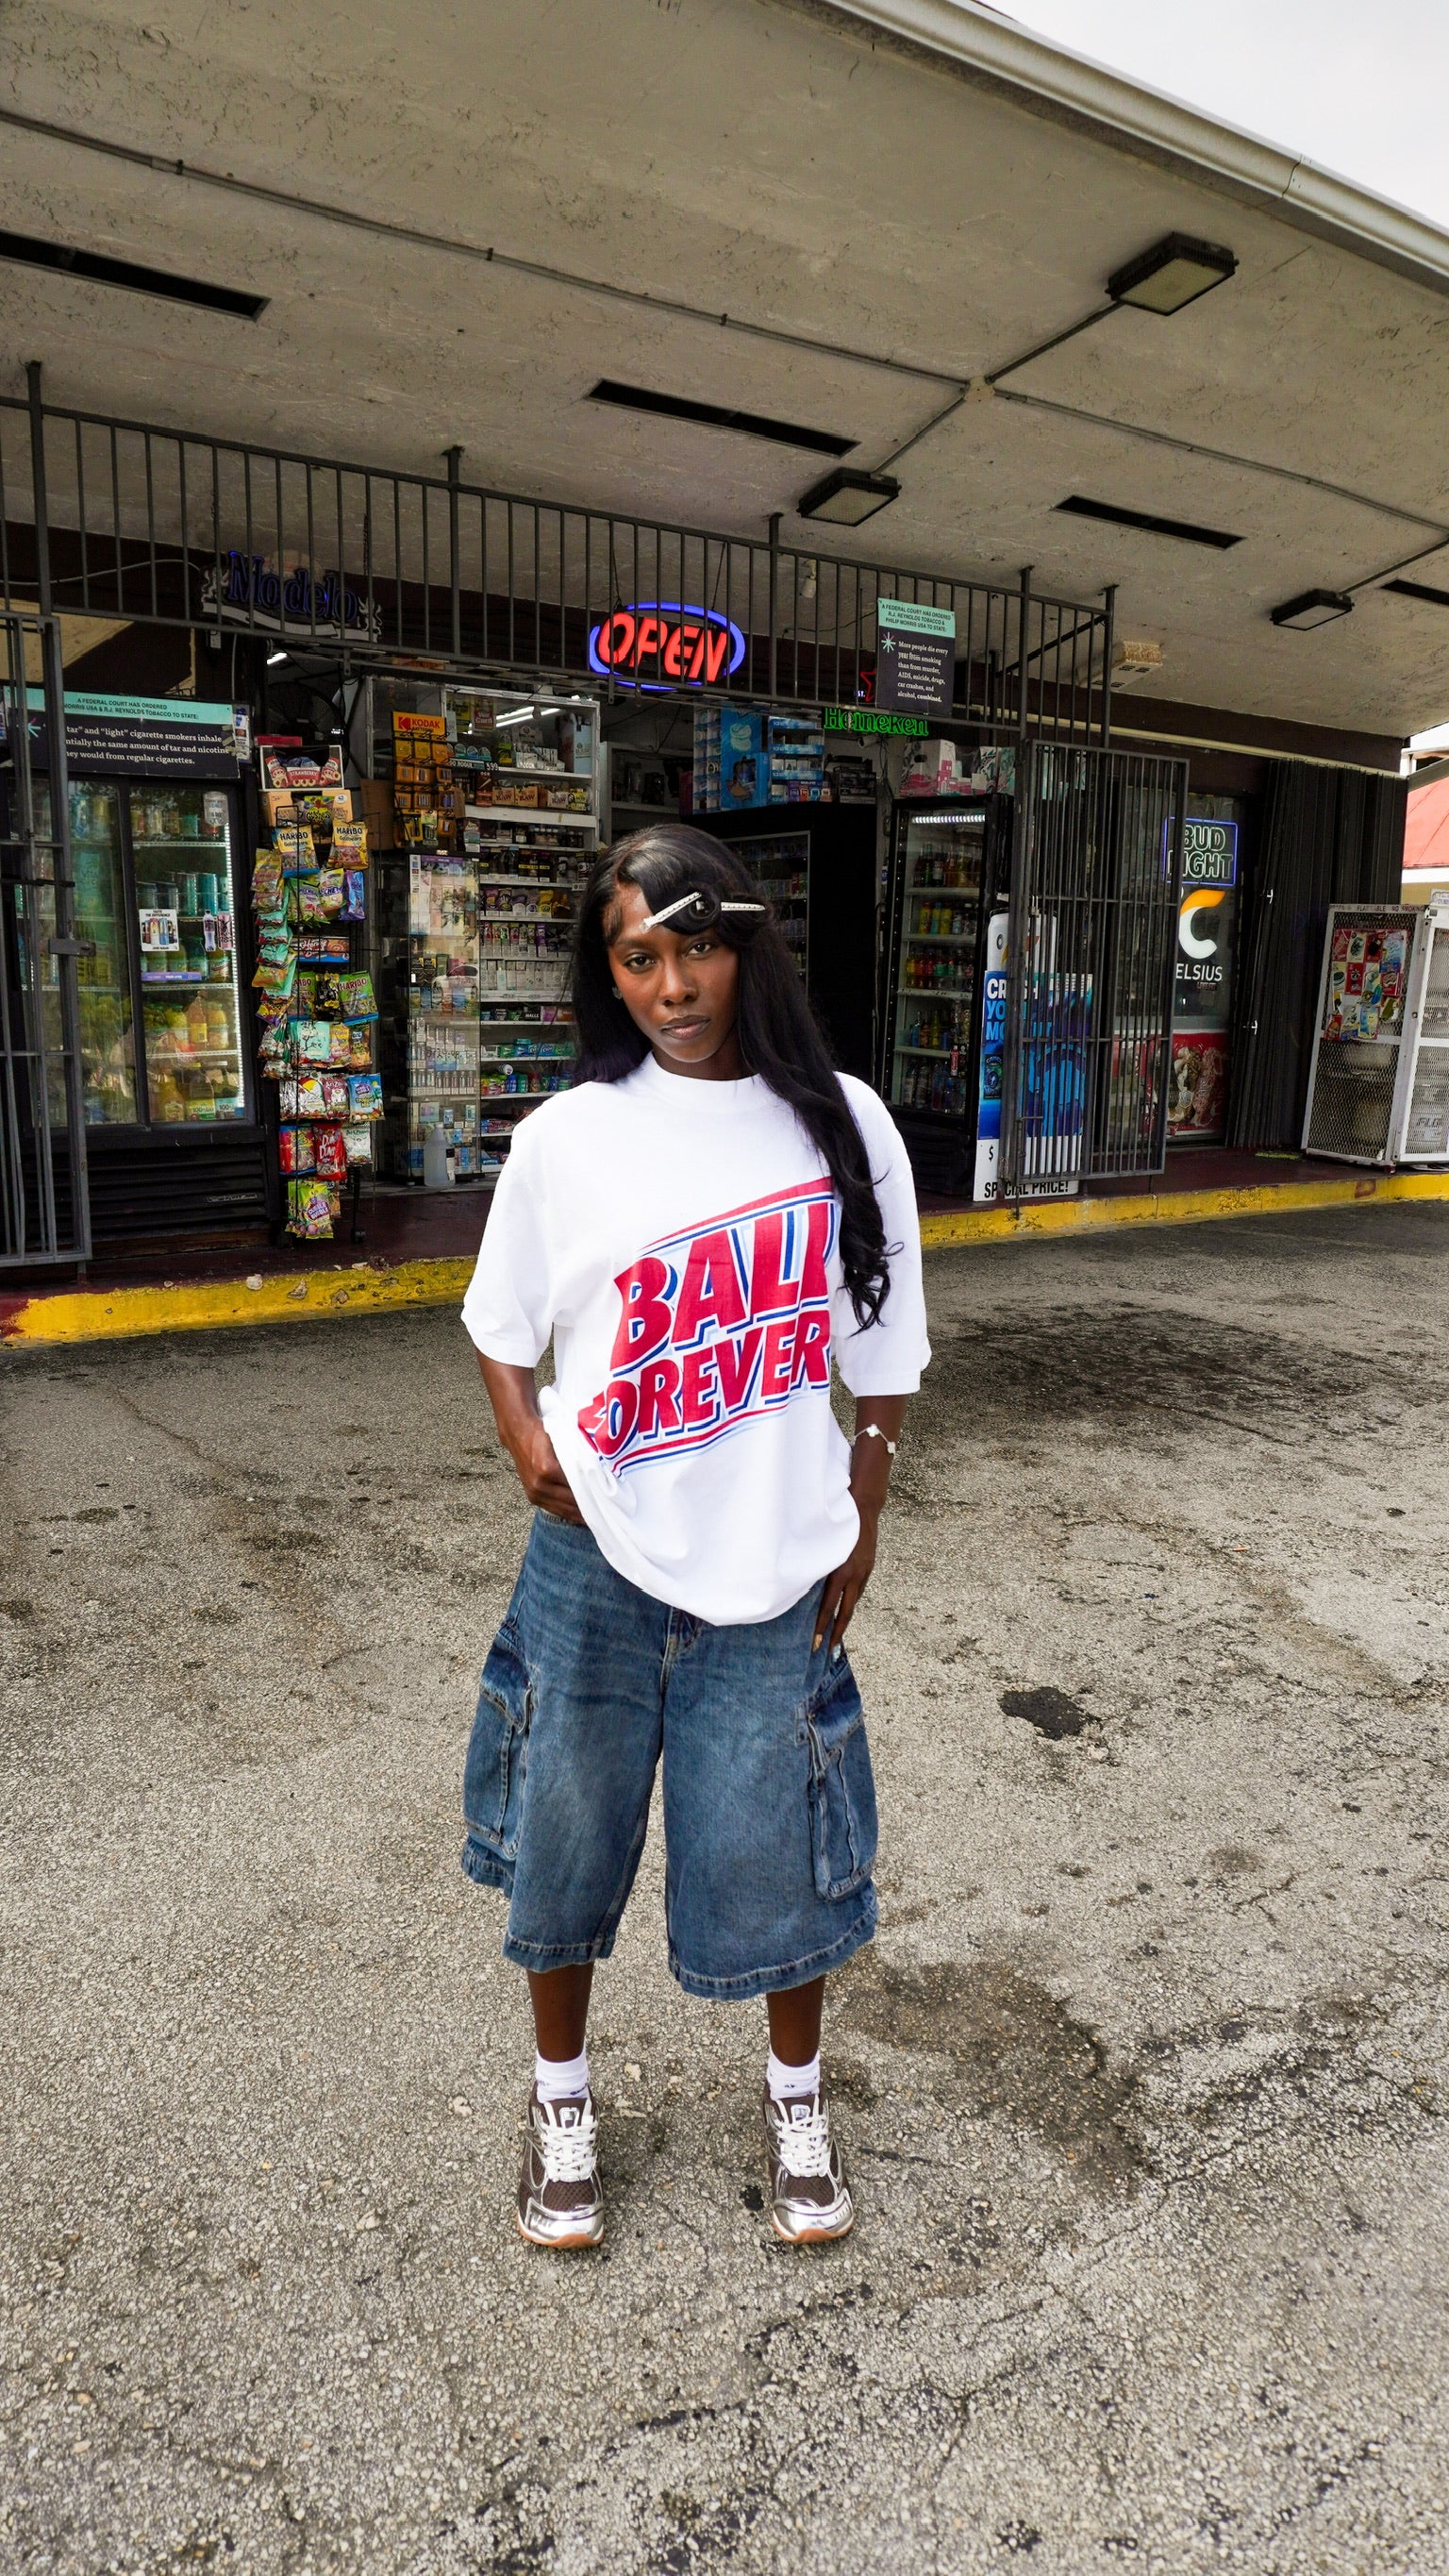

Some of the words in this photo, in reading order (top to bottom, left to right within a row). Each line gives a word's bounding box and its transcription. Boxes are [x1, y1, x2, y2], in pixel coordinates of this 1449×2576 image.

[226, 550, 358, 623] Modelo
[898, 613, 921, 621] REYNOLDS
[932, 612, 951, 620] ORDERED
[599, 612, 728, 682] OPEN
[909, 652, 921, 661] from
[921, 656, 941, 666] smoking
[898, 672, 912, 680] AIDS,
[913, 674, 930, 682] suicide,
[931, 677, 946, 685] drugs,
[906, 683, 925, 691] crashes,
[898, 691, 916, 699] alcohol,
[917, 694, 942, 703] combined.
[412, 718, 440, 728] KODAK
[824, 708, 929, 736] Heineken
[130, 729, 163, 739] cigarette
[198, 734, 222, 742] inhale
[65, 738, 92, 747] ntially
[126, 754, 155, 762] regular
[155, 755, 195, 764] cigarettes.
[280, 832, 308, 840] HARIBO
[1184, 824, 1226, 852] BUD
[1176, 963, 1223, 981] ELSIUS
[339, 978, 366, 990] HARIBO
[987, 978, 1038, 1000] CRH
[989, 1145, 994, 1162] $
[984, 1181, 1029, 1198] SPCIAL
[1032, 1181, 1068, 1194] PRICE!
